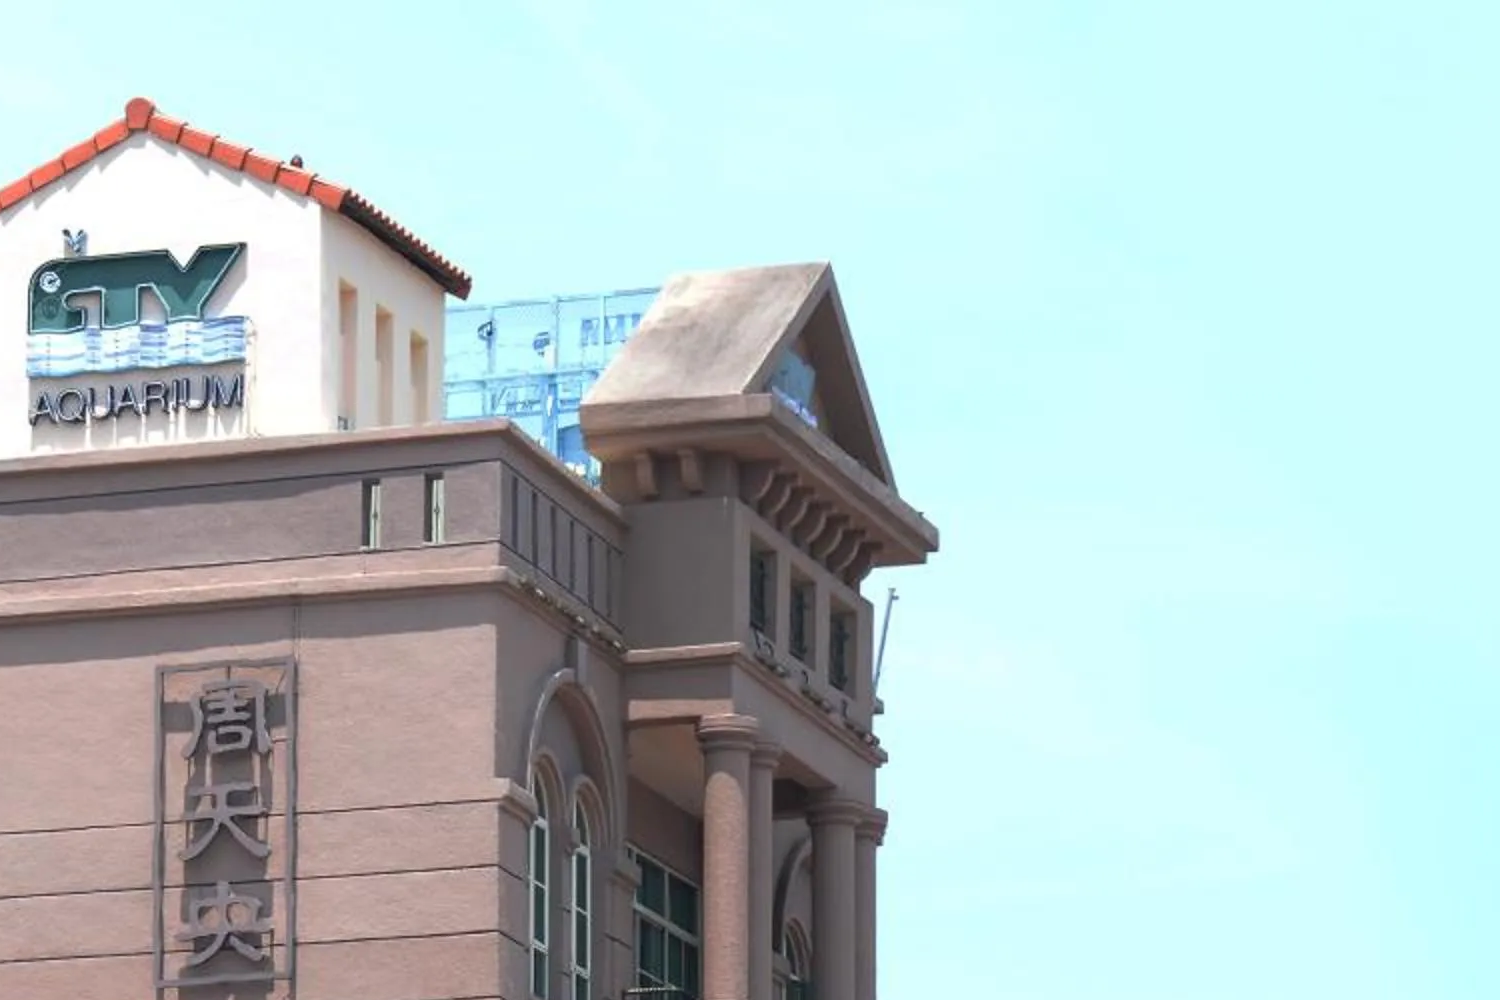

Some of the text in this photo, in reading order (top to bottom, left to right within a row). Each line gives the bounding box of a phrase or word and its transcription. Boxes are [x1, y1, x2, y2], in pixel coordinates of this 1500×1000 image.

[29, 373, 244, 426] AQUARIUM
[175, 678, 274, 967] 周天央
